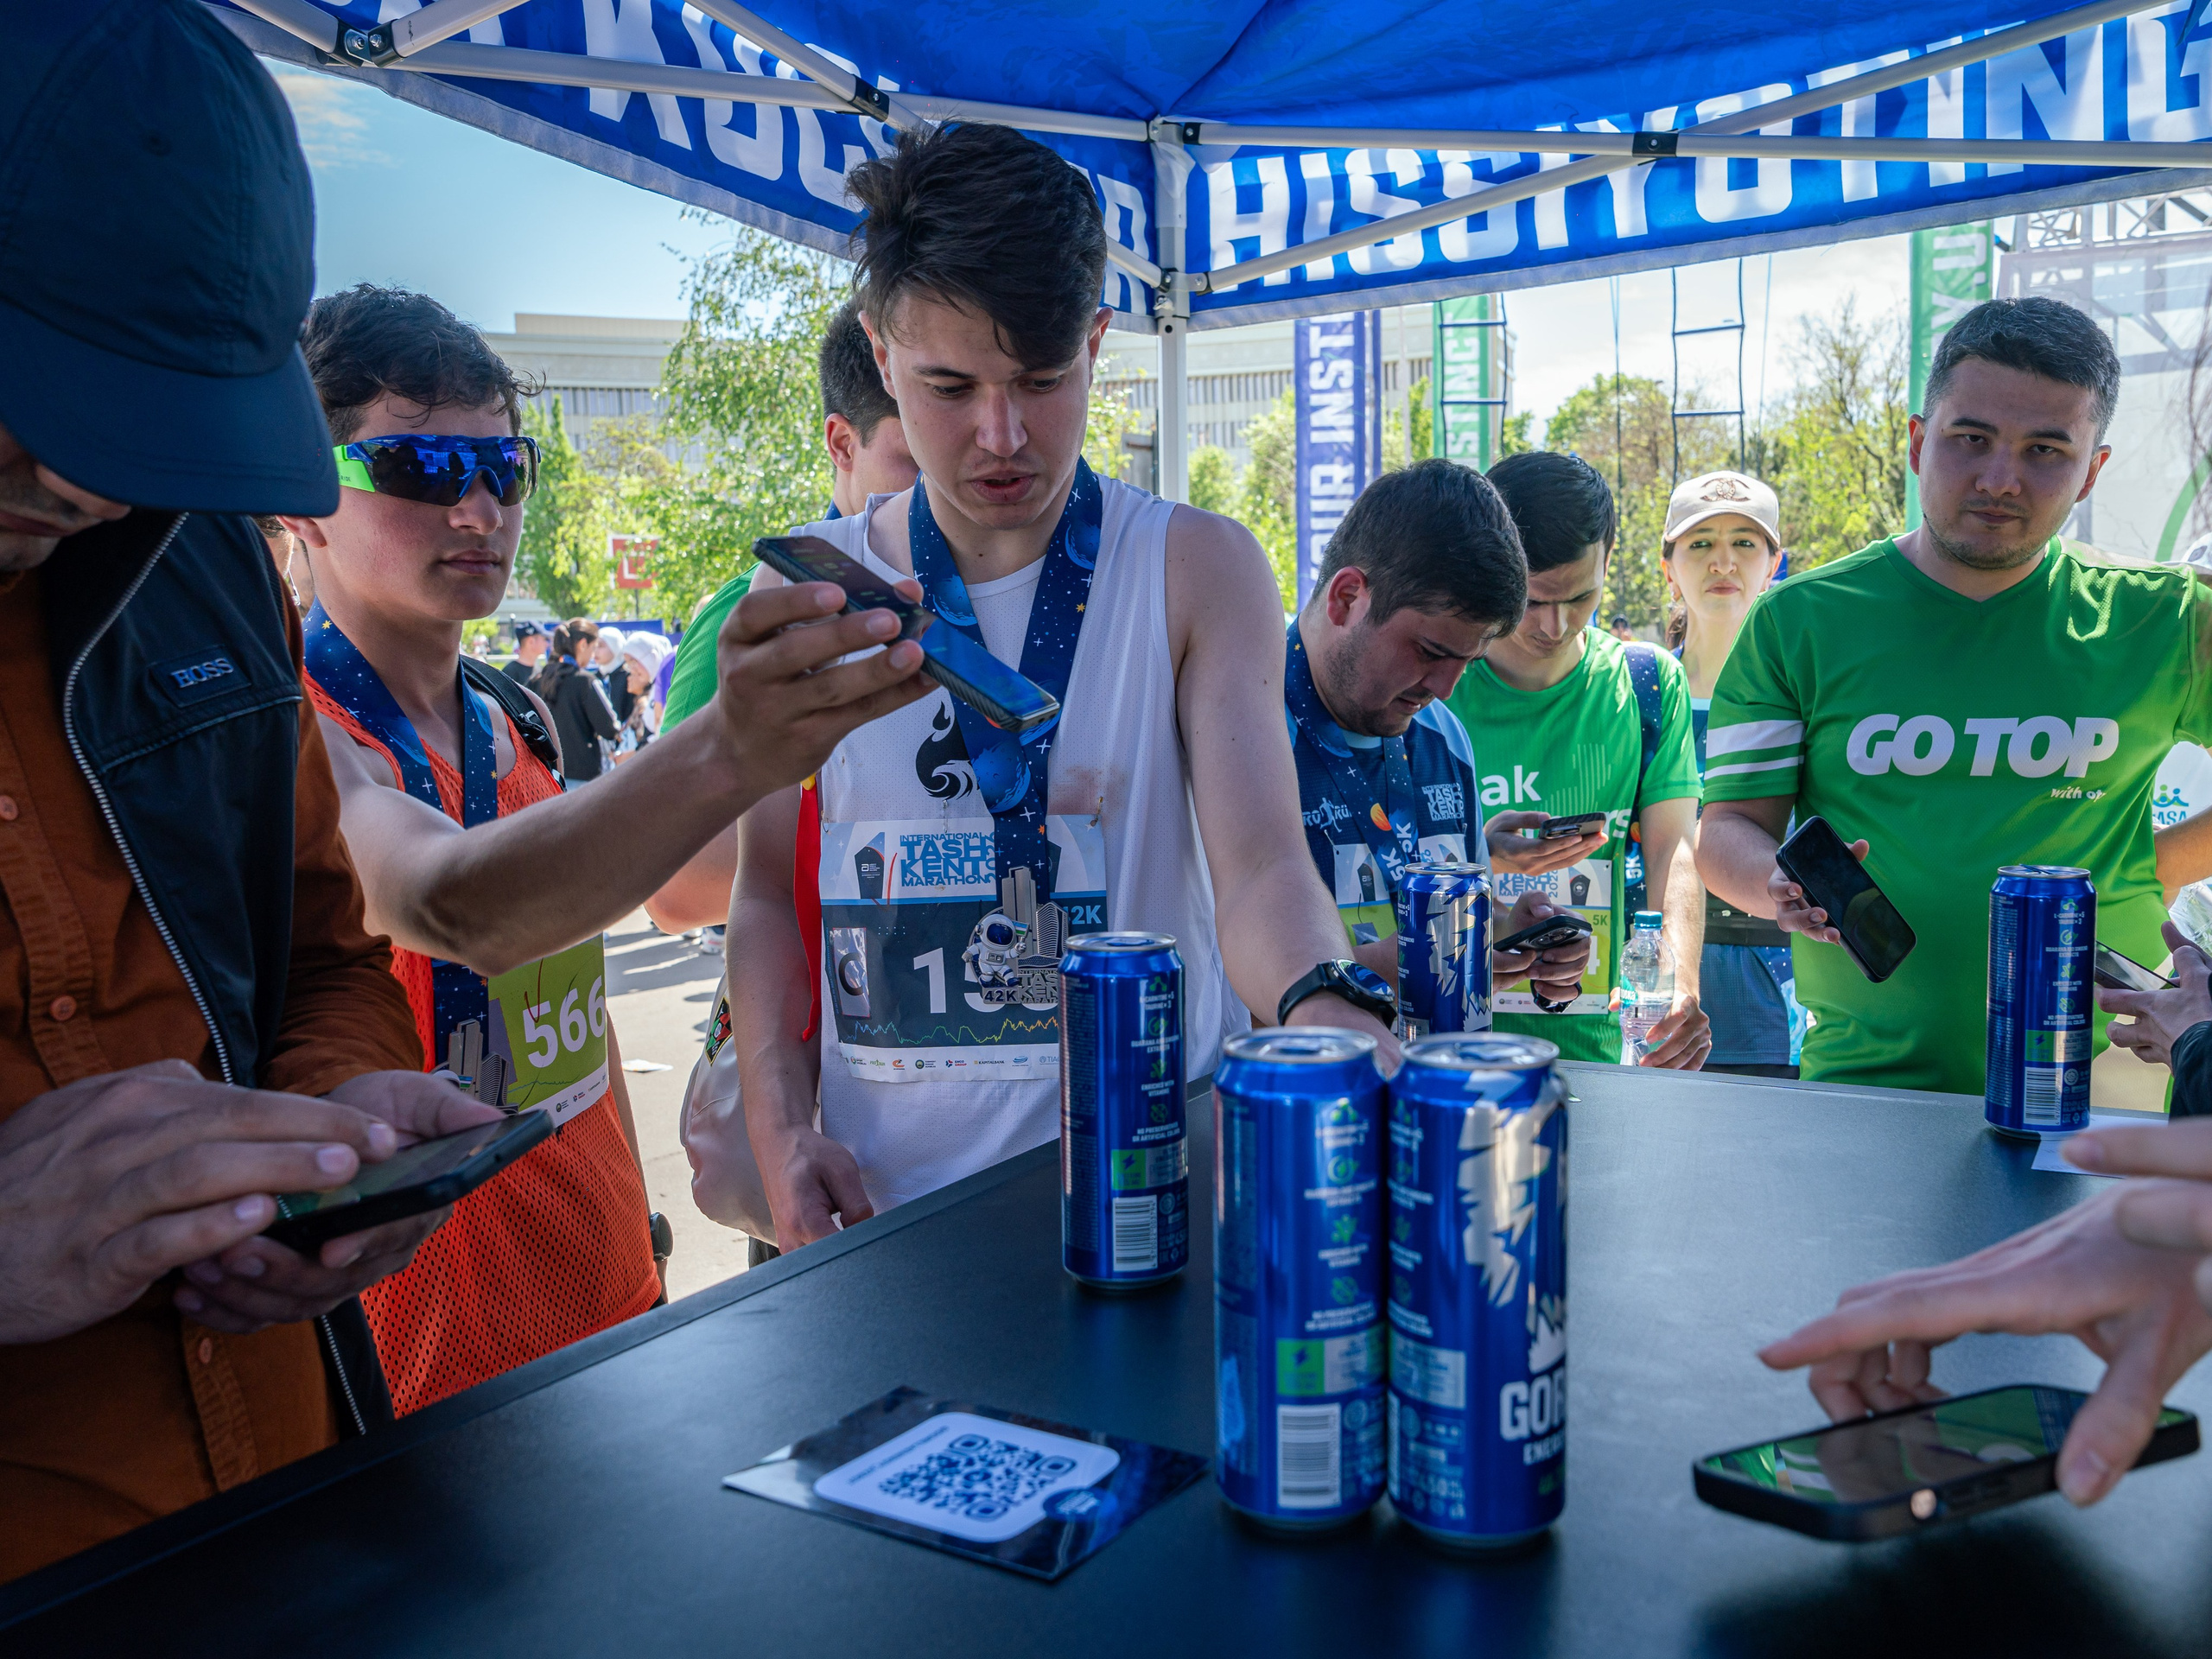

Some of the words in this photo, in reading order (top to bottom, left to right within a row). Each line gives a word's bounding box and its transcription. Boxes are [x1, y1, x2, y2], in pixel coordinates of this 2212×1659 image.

[1309, 462, 1355, 581] OUR
[170, 657, 234, 689] BOSS
[1846, 713, 1955, 776] GO
[1964, 715, 2120, 779] TOP
[2050, 785, 2082, 799] with
[900, 832, 982, 842] INTERNATIONAL
[900, 837, 987, 861] TASH
[900, 858, 986, 879] KENT
[1381, 847, 1407, 882] 5K
[1625, 855, 1643, 880] 5K
[901, 874, 987, 887] MARATHON
[1592, 914, 1608, 926] 5K
[1018, 974, 1058, 987] TAS
[984, 989, 1018, 1002] 42K
[1018, 986, 1058, 999] KEN
